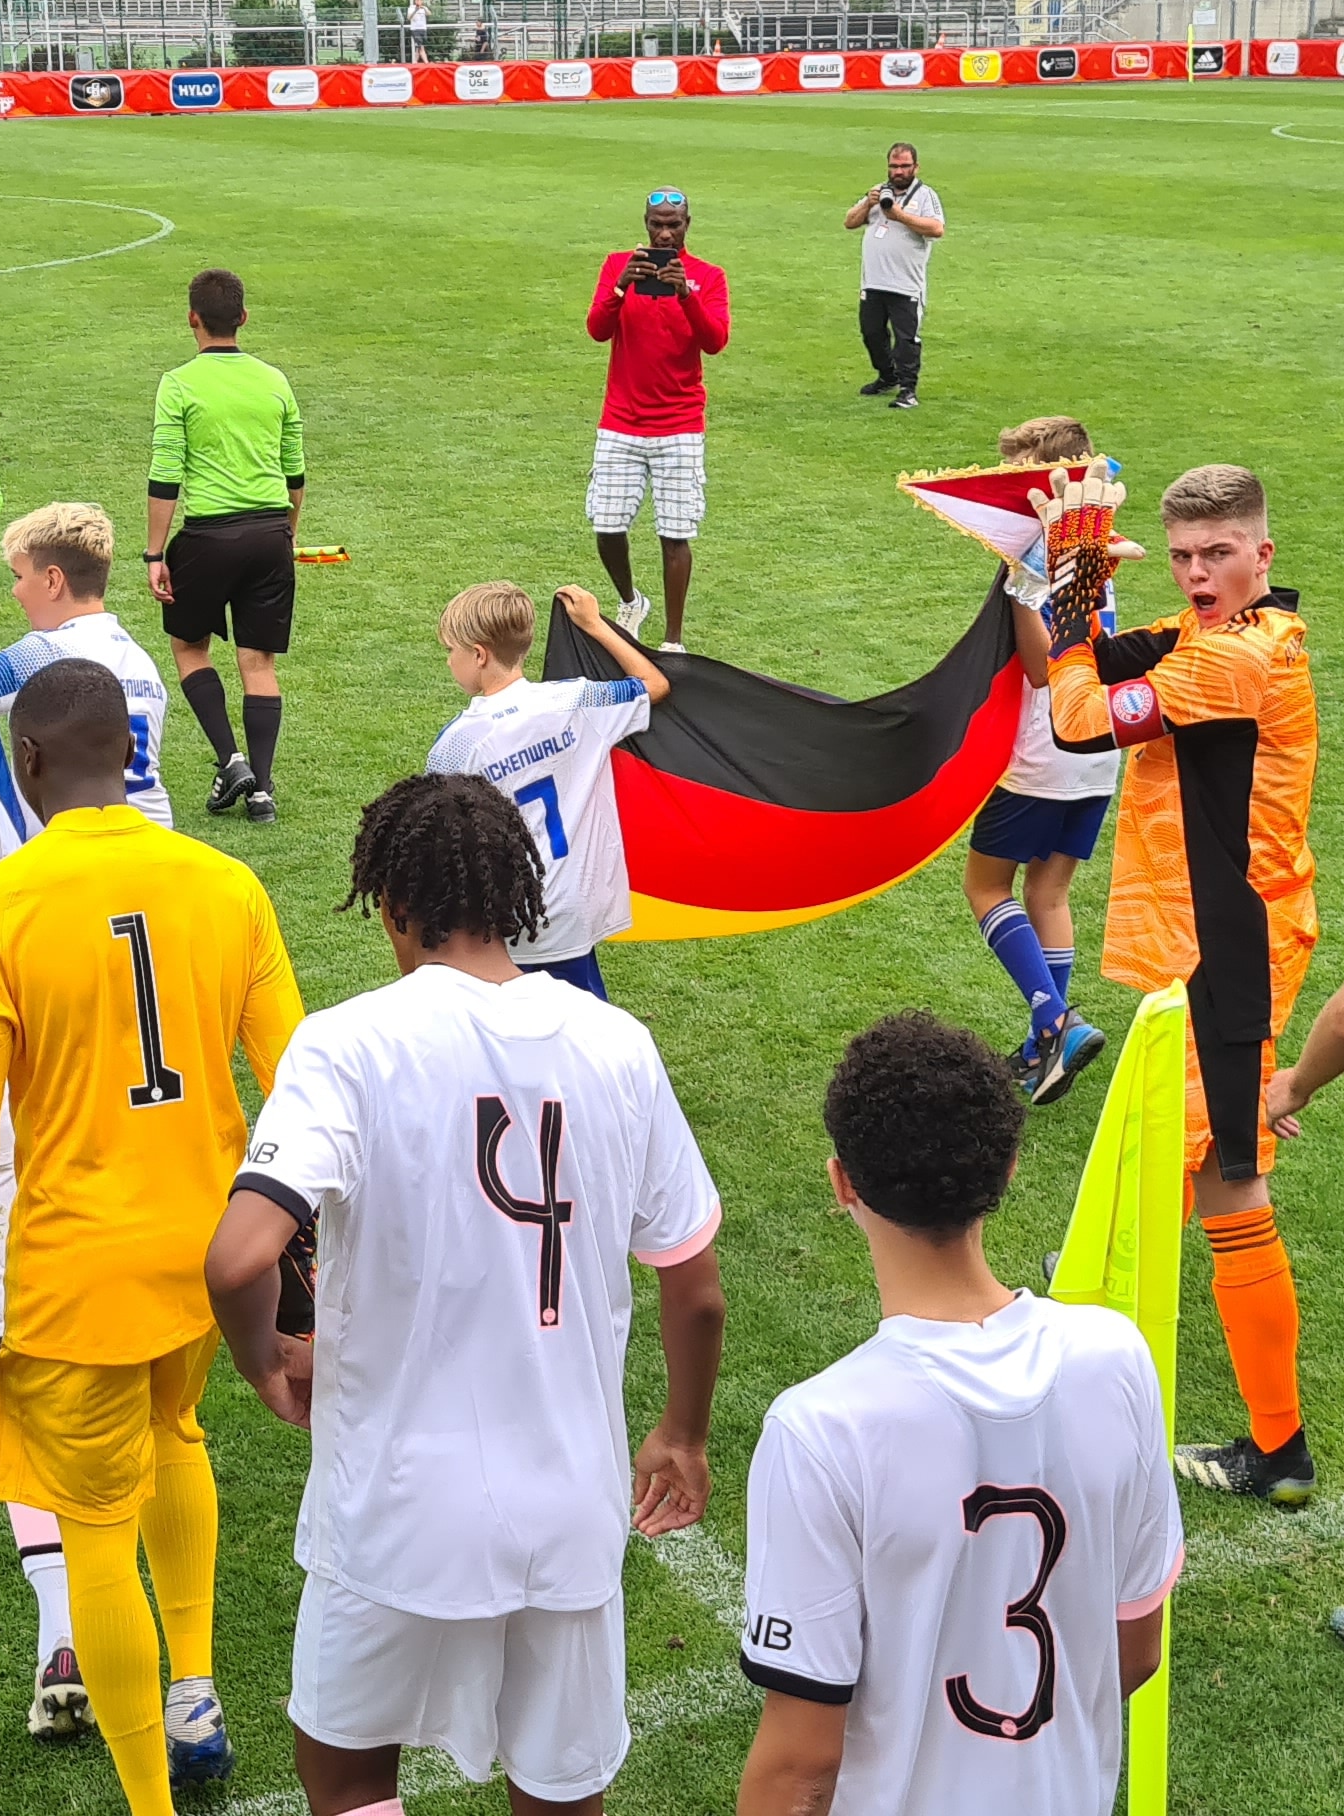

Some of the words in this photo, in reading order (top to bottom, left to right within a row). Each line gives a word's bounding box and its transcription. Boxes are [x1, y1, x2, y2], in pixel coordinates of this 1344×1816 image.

[178, 84, 213, 96] HYLO
[468, 70, 483, 78] SO
[469, 79, 489, 87] USE
[553, 71, 581, 84] SEO
[513, 774, 569, 861] 7
[106, 911, 184, 1109] 1
[473, 1093, 575, 1330] 4
[943, 1483, 1068, 1743] 3
